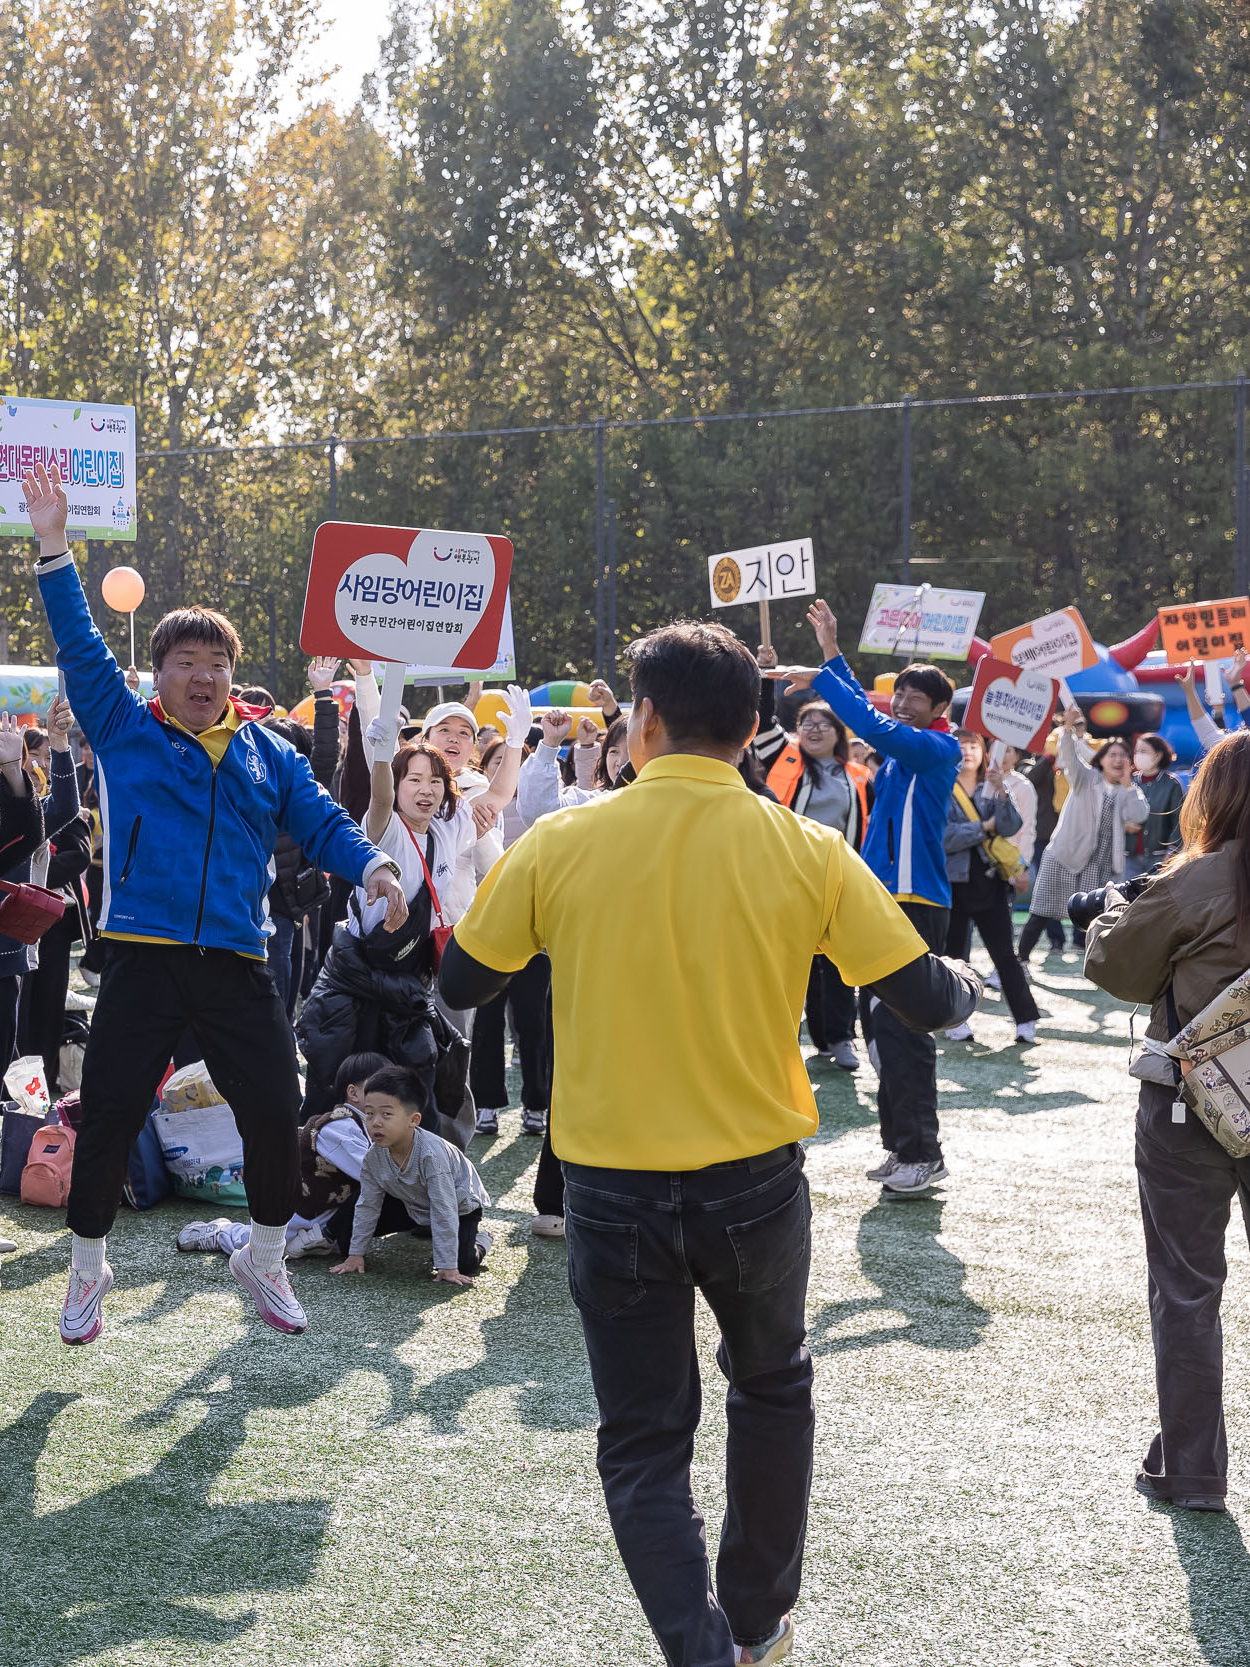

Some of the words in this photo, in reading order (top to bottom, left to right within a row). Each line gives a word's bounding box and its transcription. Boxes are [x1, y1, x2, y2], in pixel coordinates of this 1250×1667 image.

[18, 502, 101, 516] 광이집연합회
[745, 547, 810, 596] 지안
[338, 574, 484, 612] 사임당어린이집
[350, 614, 463, 634] 광진구민간어린이집연합회
[1176, 632, 1244, 655] 어린이집
